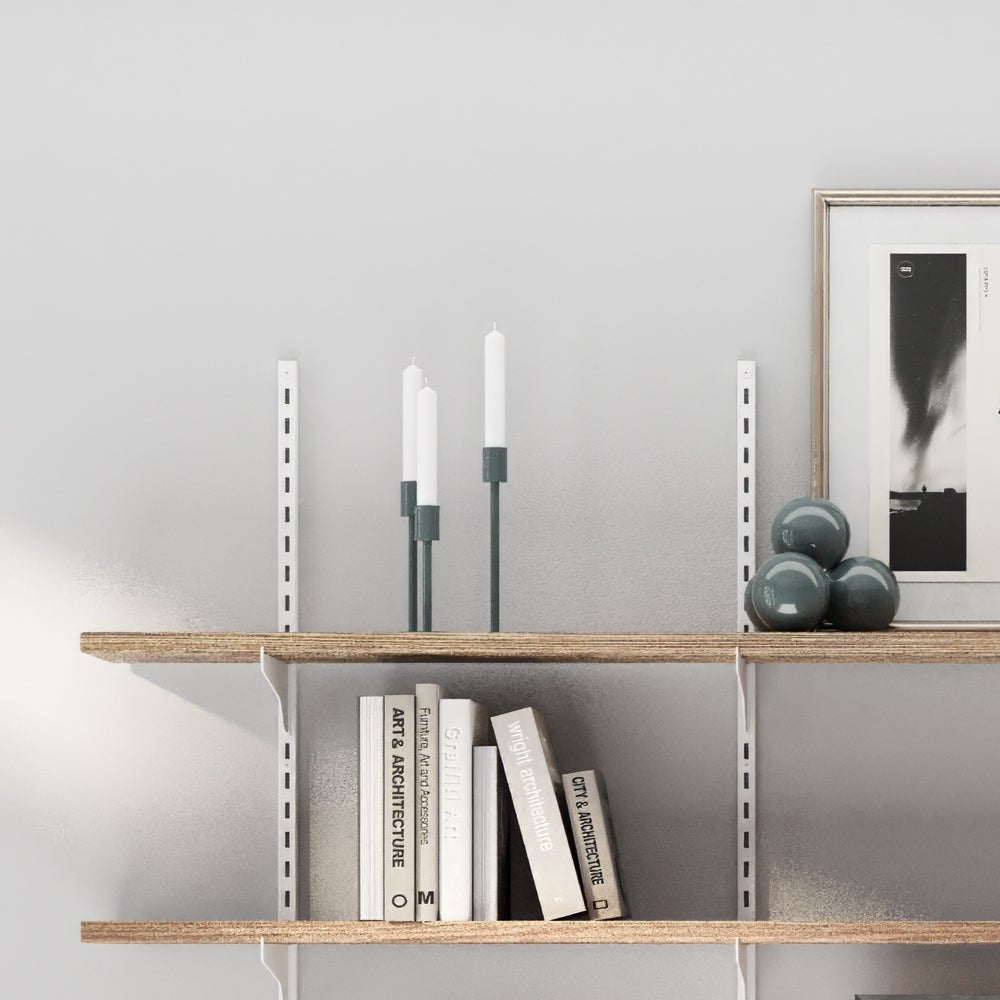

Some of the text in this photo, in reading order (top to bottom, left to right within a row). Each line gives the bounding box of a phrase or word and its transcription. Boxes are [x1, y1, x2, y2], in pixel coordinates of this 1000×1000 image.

[392, 707, 405, 868] ART & ARCHITECTURE
[419, 753, 431, 767] Art
[419, 769, 431, 788] and
[507, 720, 555, 852] wright architecture
[570, 776, 605, 886] CITY & ARCHITECTURE
